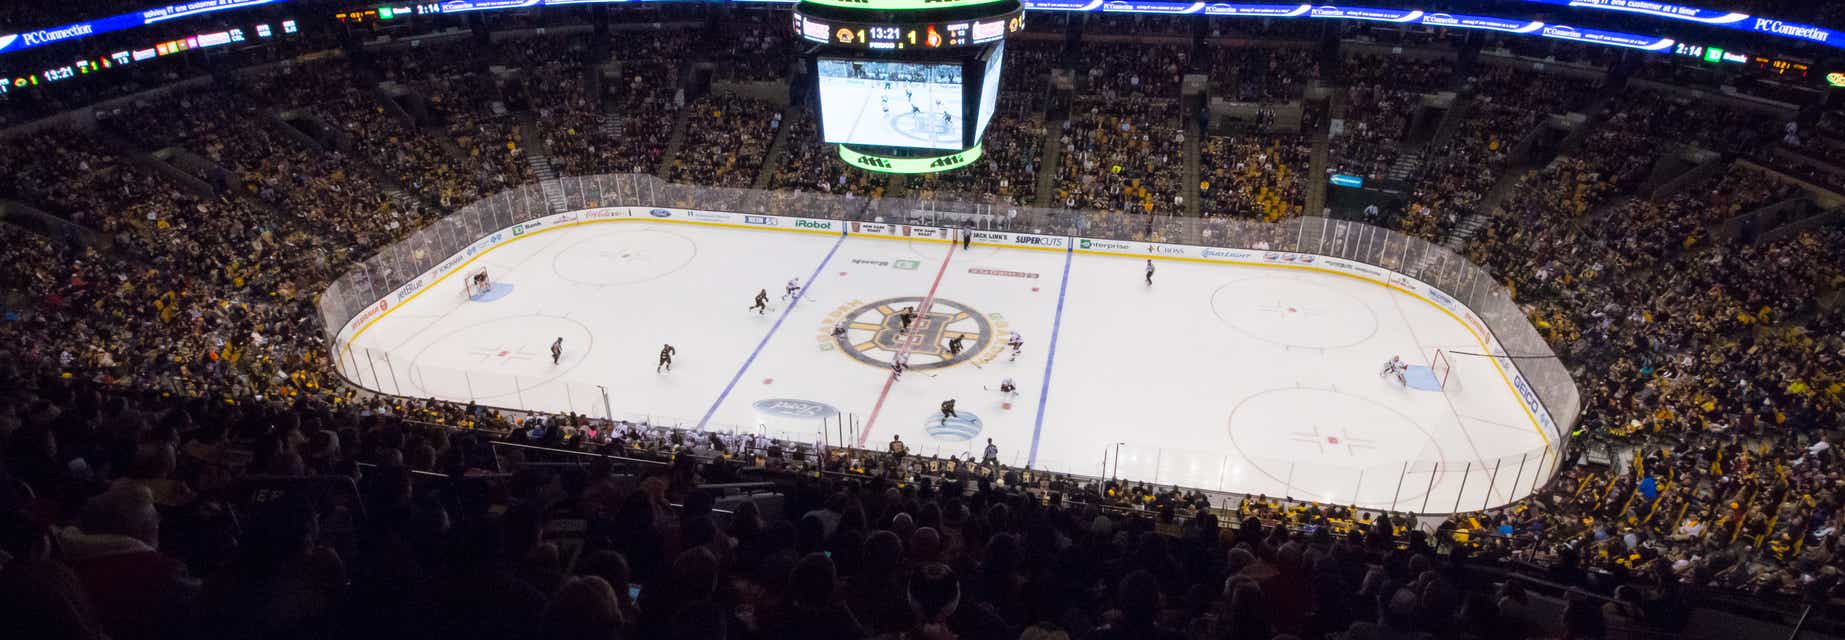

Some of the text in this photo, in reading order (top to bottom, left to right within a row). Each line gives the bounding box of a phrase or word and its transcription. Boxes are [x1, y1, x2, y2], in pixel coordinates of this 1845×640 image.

[417, 4, 440, 14] 2:14
[22, 24, 93, 46] PC Connection
[857, 29, 865, 43] 1
[870, 27, 900, 39] 13:21
[1754, 18, 1829, 42] PC Connection
[907, 30, 916, 45] 1
[1675, 43, 1702, 57] 2:14
[44, 66, 74, 81] 13:21
[795, 219, 831, 229] iRobot
[1015, 235, 1062, 247] SUPERCUTS
[1513, 375, 1539, 414] GEICO
